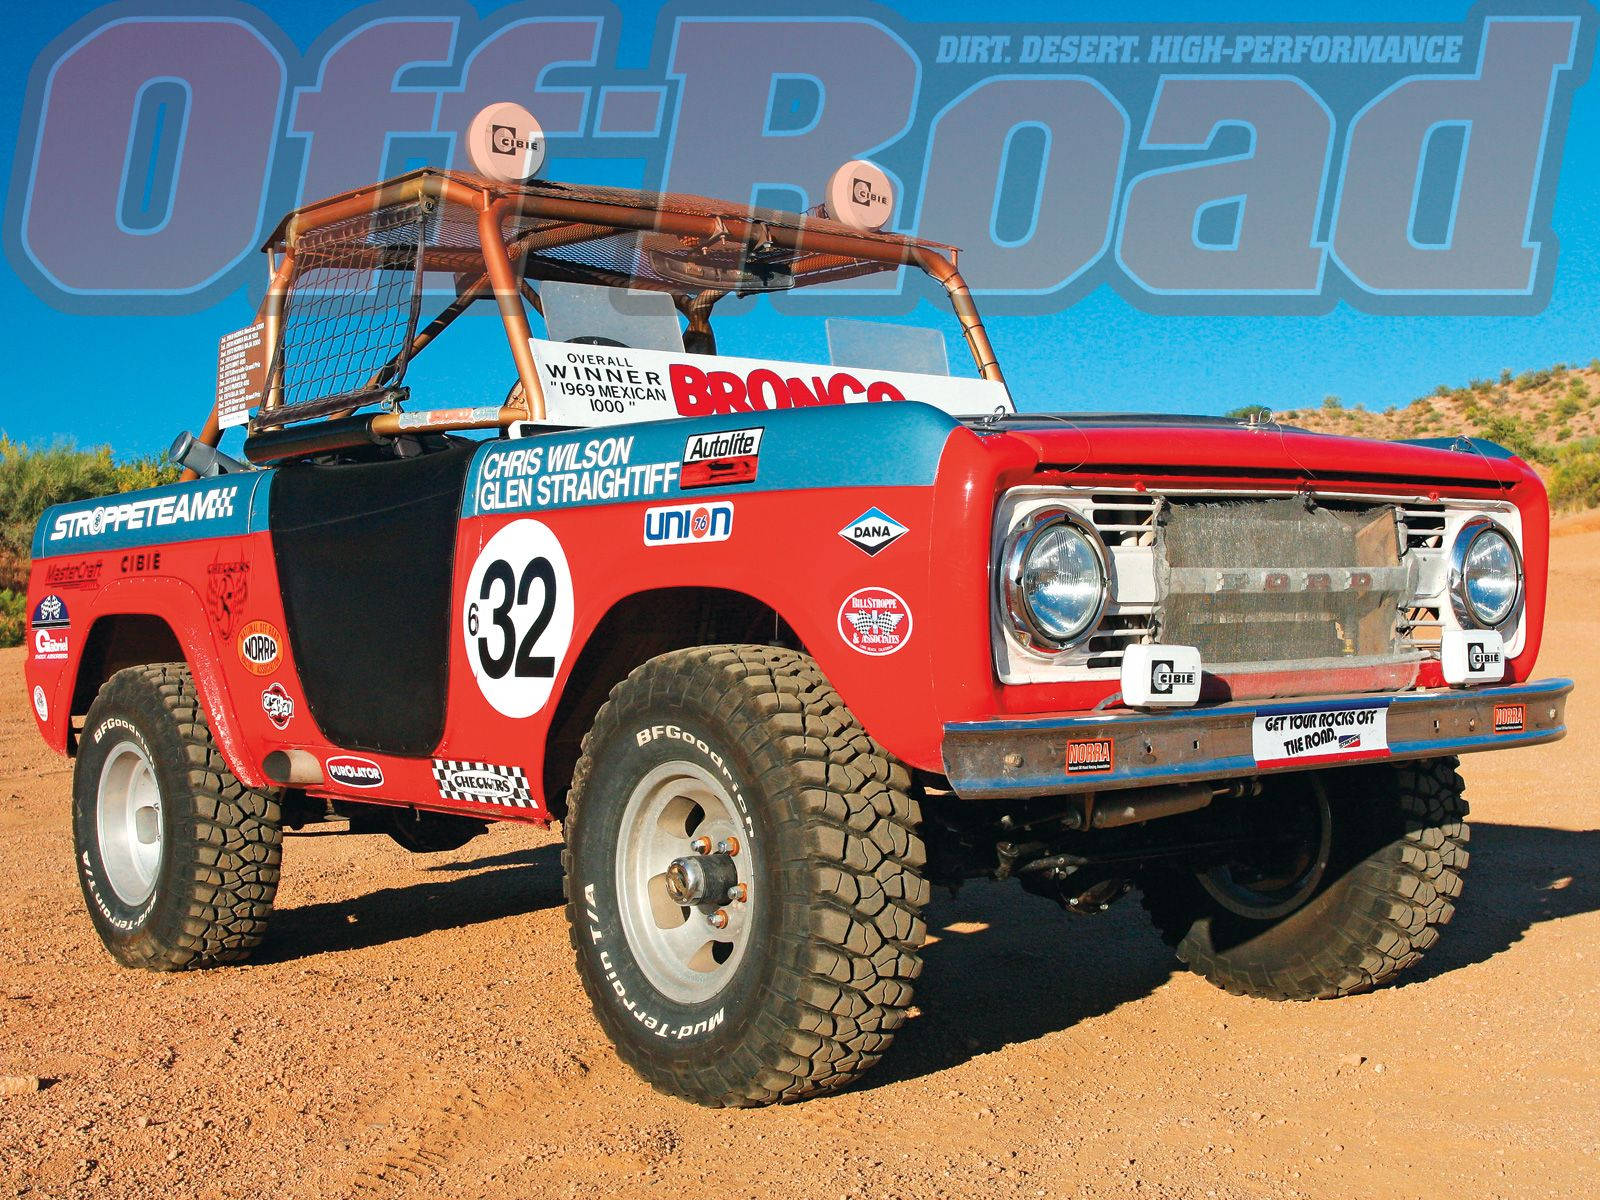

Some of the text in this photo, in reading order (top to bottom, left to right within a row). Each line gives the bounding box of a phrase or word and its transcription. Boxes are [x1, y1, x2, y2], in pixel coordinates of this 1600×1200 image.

[566, 352, 635, 368] OVERALL
[544, 363, 663, 386] WINNER
[599, 383, 668, 402] MEXICAN
[482, 436, 635, 480] CHRIS WILSON
[689, 432, 755, 460] Autolite
[479, 461, 681, 511] GLEN STRAIGHTIFF
[853, 525, 891, 539] DANA
[467, 602, 479, 637] 6
[478, 556, 557, 679] 32
[244, 635, 277, 661] NORRA
[1264, 709, 1378, 732] GET YOUR ROCKS OFF
[1495, 706, 1524, 725] NORRA
[1068, 742, 1111, 765] NORRA
[1283, 727, 1338, 756] THE ROAD.
[329, 764, 381, 781] PUROLATOR
[584, 882, 725, 1040] Mud-Terrain T/A
